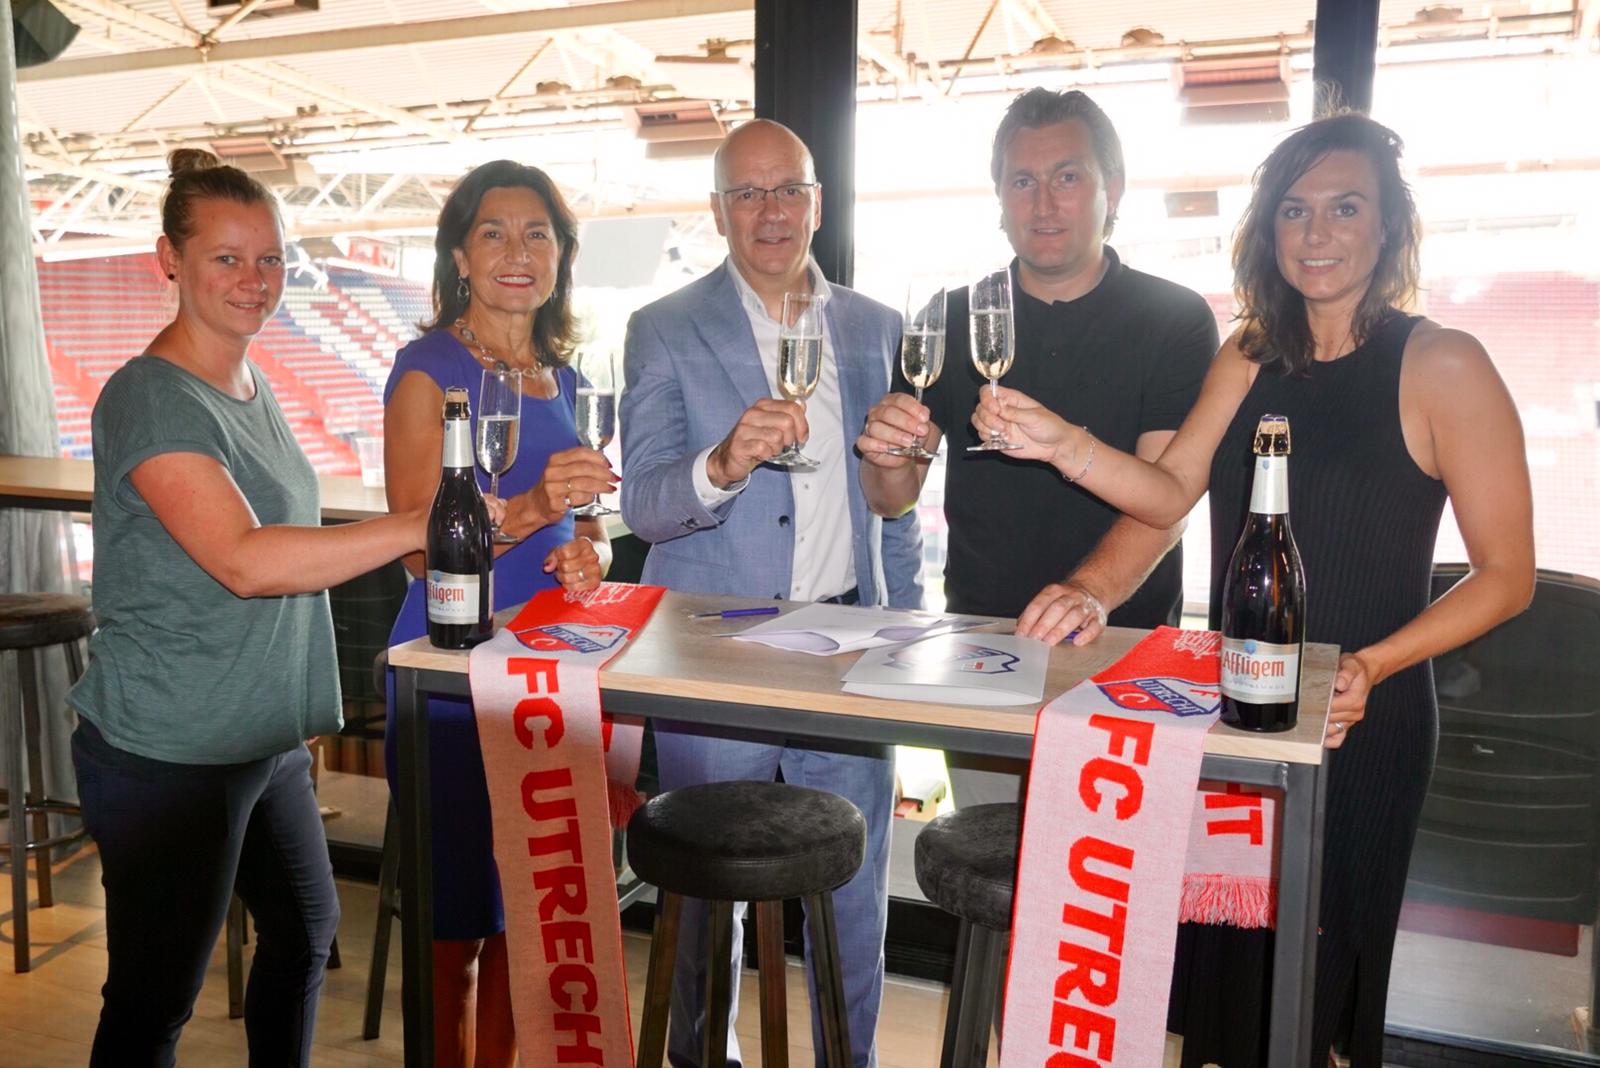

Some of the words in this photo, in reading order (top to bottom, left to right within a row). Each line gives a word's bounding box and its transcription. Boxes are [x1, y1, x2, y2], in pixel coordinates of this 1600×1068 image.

[507, 657, 565, 750] FC
[1135, 679, 1208, 714] UTRECHT
[1223, 650, 1285, 680] Affligem
[1078, 713, 1155, 820] FC
[521, 767, 604, 1068] UTRECH
[1044, 835, 1135, 1068] UTRE
